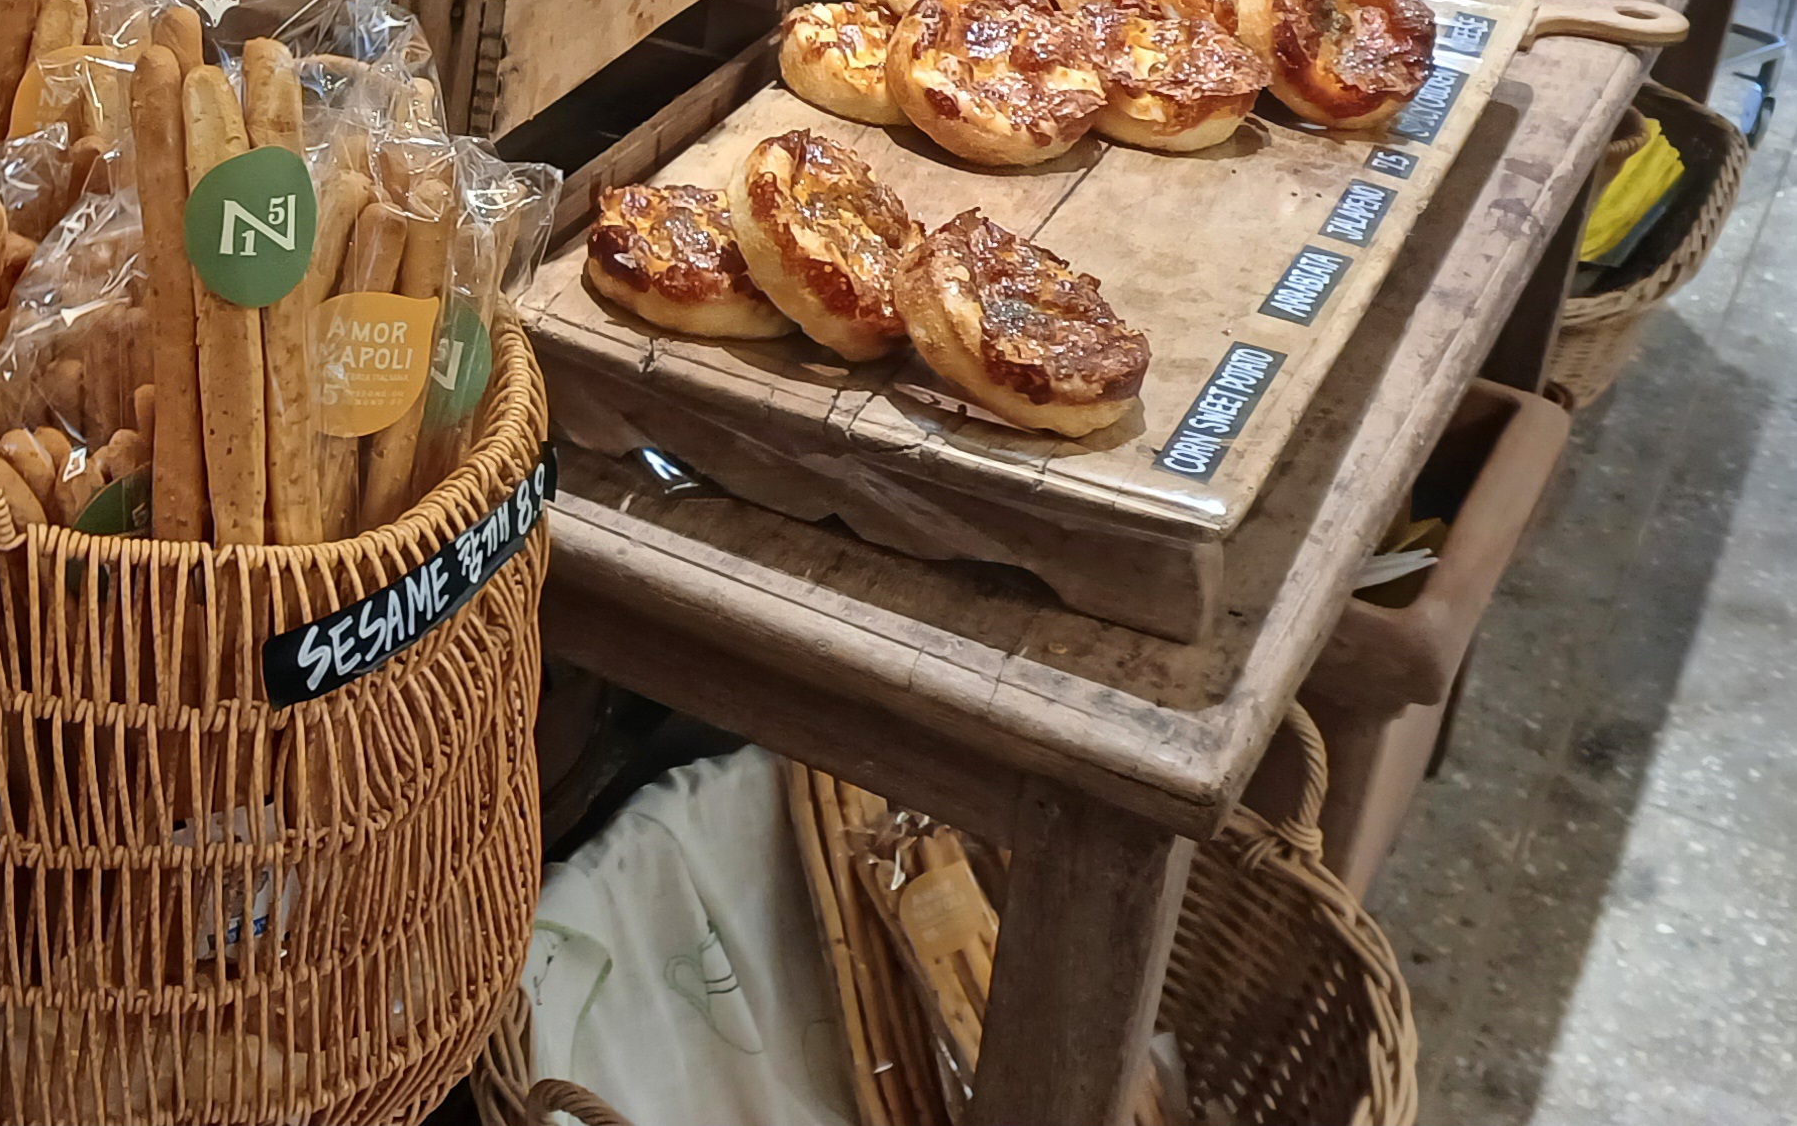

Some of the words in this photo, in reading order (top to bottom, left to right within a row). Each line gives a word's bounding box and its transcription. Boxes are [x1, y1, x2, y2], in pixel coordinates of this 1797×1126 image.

[1326, 183, 1386, 242] JALAPENO
[1269, 251, 1344, 318] ARRABIATA
[327, 316, 408, 344] AMOR
[1215, 347, 1275, 394] POTATO
[1188, 384, 1250, 434] SWEET
[1162, 429, 1223, 474] CORN
[297, 557, 450, 691] SESAME
[516, 462, 545, 535] 8.9
